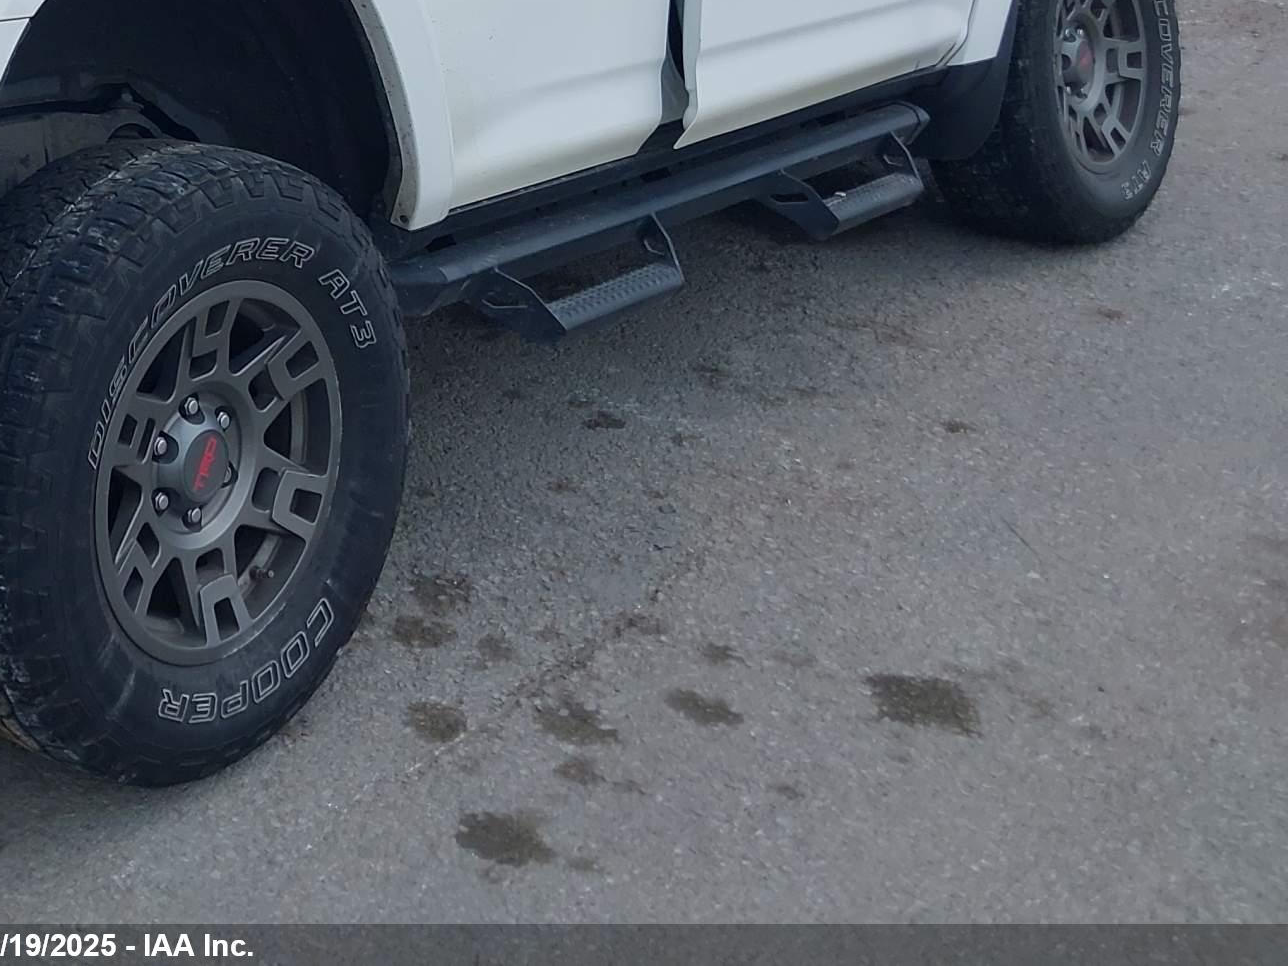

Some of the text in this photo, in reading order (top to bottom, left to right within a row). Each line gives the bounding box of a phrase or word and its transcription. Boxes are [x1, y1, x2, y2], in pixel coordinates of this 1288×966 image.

[87, 237, 377, 470] DISCOVERER AT3
[158, 597, 335, 724] COOPER
